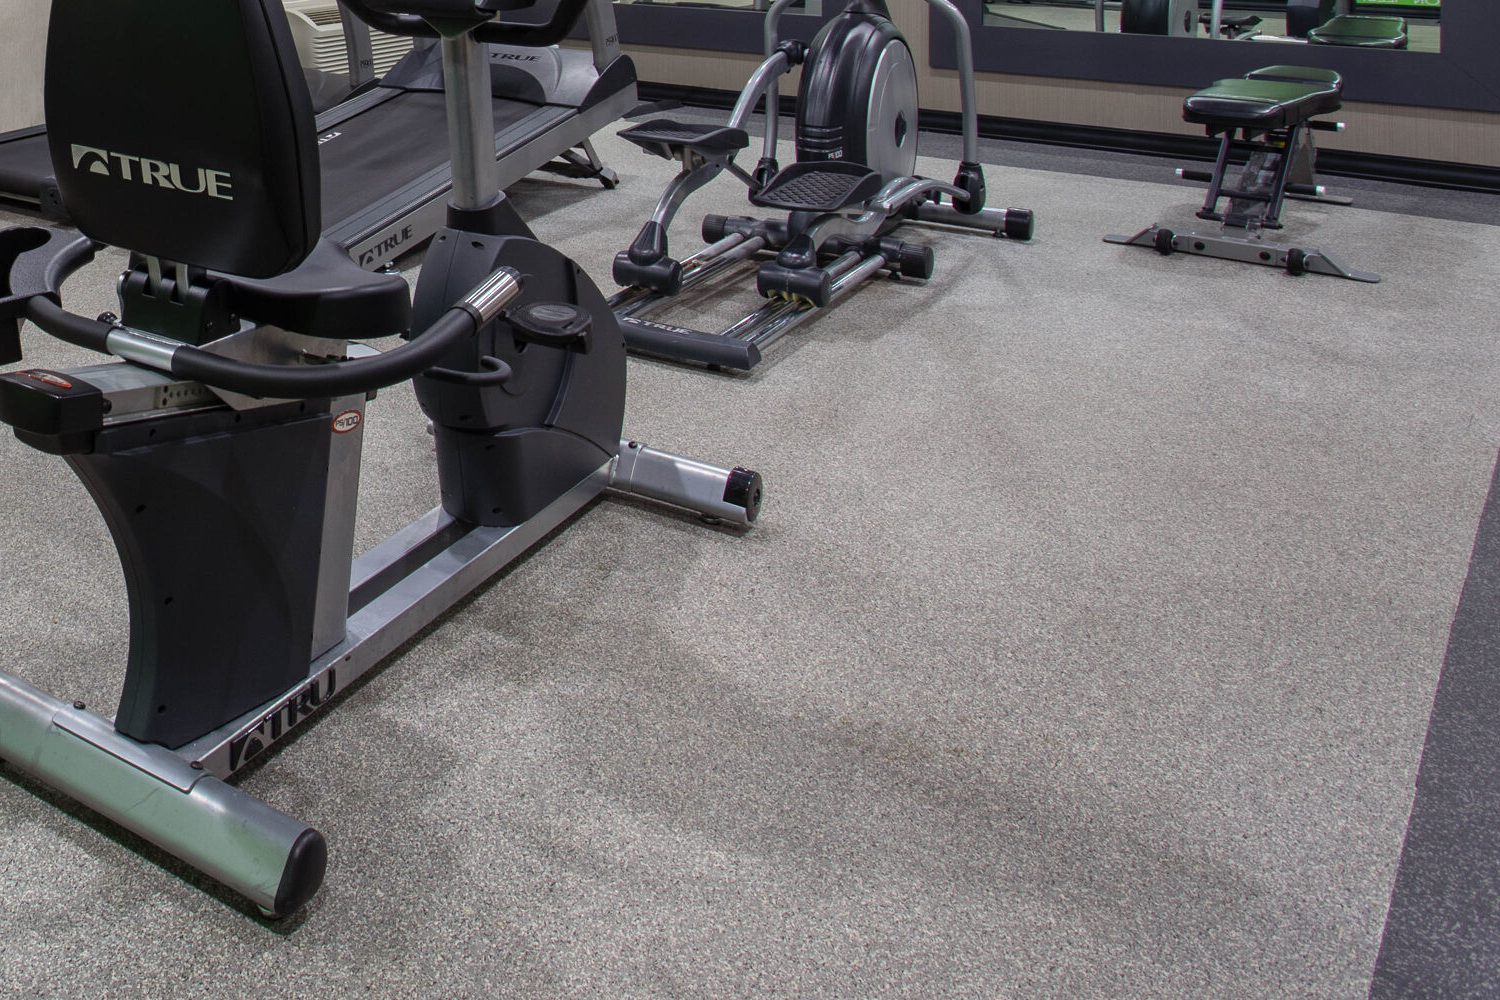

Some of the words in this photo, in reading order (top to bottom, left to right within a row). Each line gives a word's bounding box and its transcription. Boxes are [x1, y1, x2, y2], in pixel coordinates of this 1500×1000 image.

[491, 52, 542, 62] TRUE
[110, 151, 234, 201] TRUE
[374, 224, 413, 257] TRUE
[642, 320, 693, 335] TRUE
[264, 667, 336, 741] TRU
